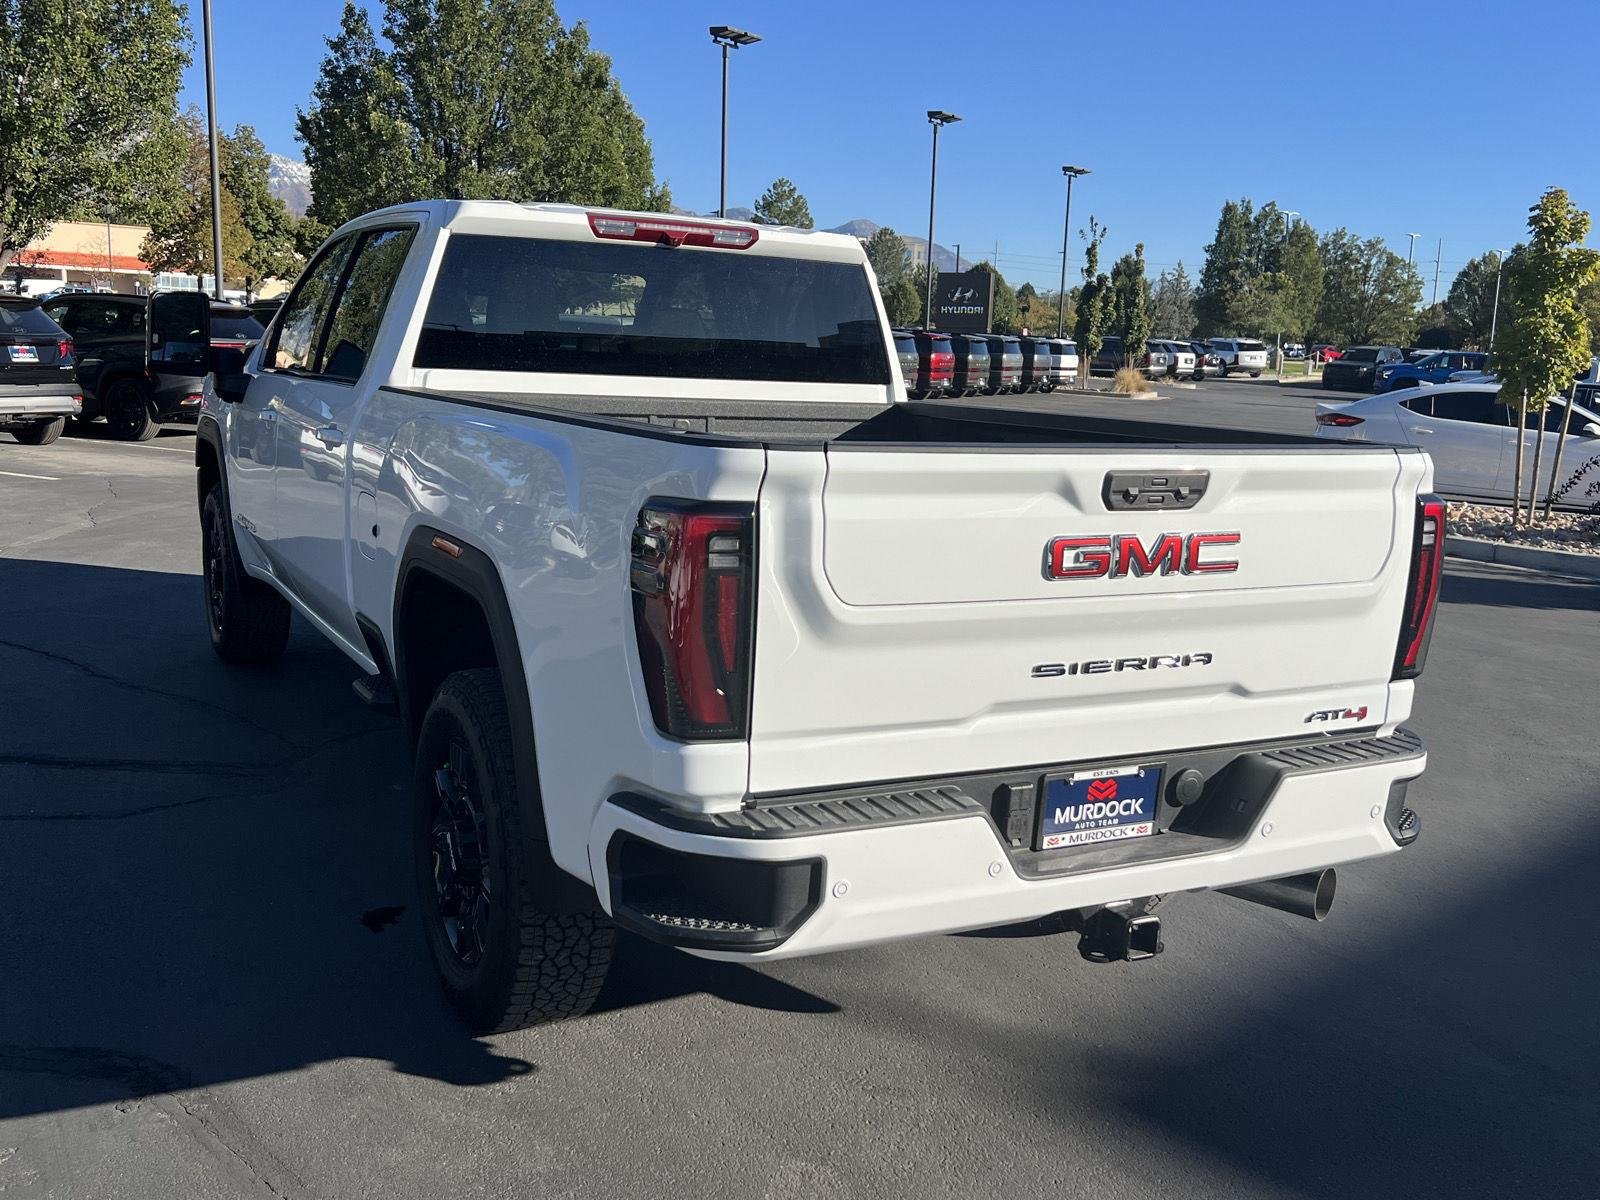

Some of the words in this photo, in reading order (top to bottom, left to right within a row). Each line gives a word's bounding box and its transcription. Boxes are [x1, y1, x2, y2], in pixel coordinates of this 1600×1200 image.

[941, 306, 984, 314] HYUNDAI
[1041, 530, 1242, 581] GMC
[1031, 652, 1213, 678] SIERRA
[1303, 705, 1368, 724] AT4
[1054, 798, 1144, 824] MURDOCK
[1075, 821, 1096, 829] AUTO
[1098, 818, 1119, 827] TEAM
[1069, 827, 1128, 844] MURDOCK
